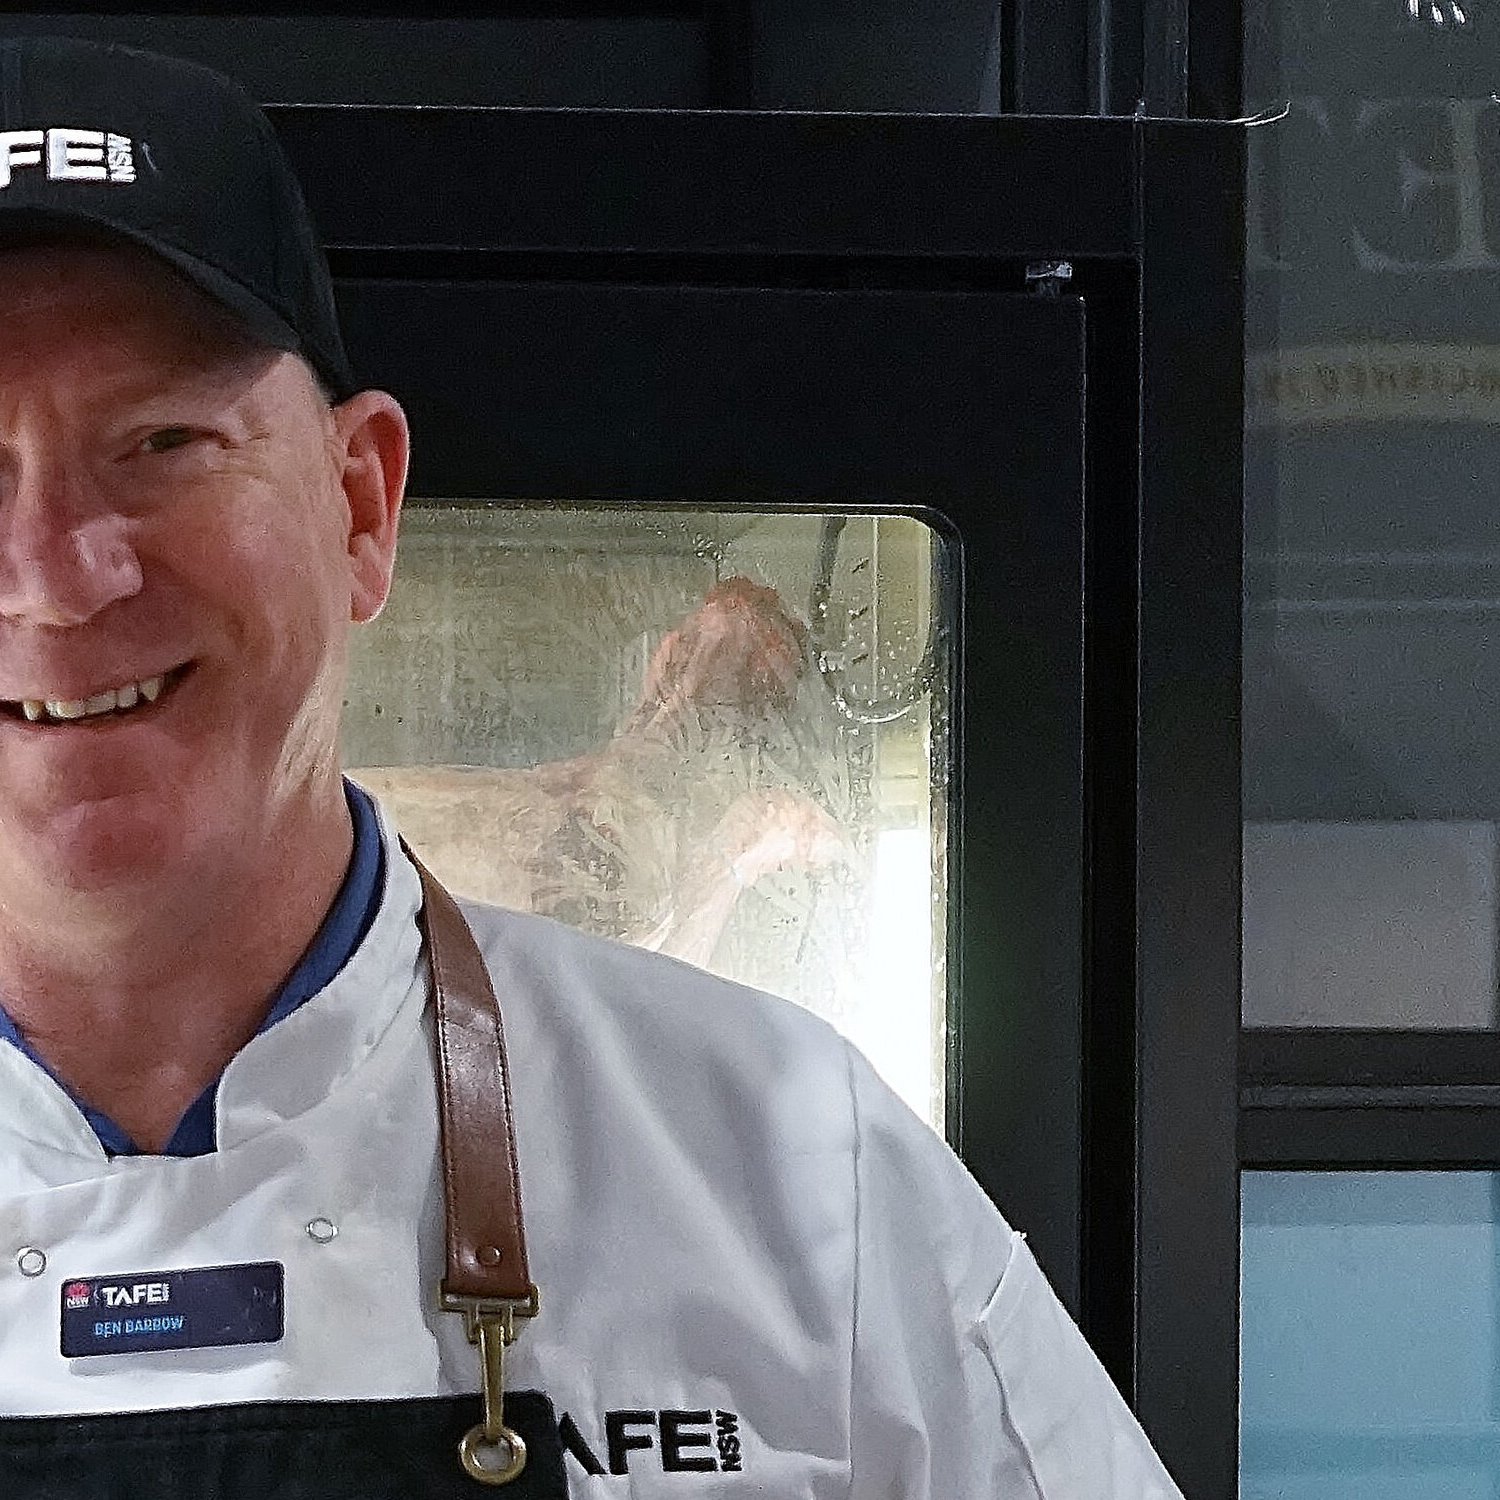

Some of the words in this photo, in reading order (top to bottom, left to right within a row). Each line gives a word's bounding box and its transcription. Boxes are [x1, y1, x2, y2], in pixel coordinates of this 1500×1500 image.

[102, 1283, 162, 1306] TAFE
[95, 1321, 121, 1337] BEN
[558, 1409, 718, 1475] AFE
[715, 1409, 743, 1472] NSW
